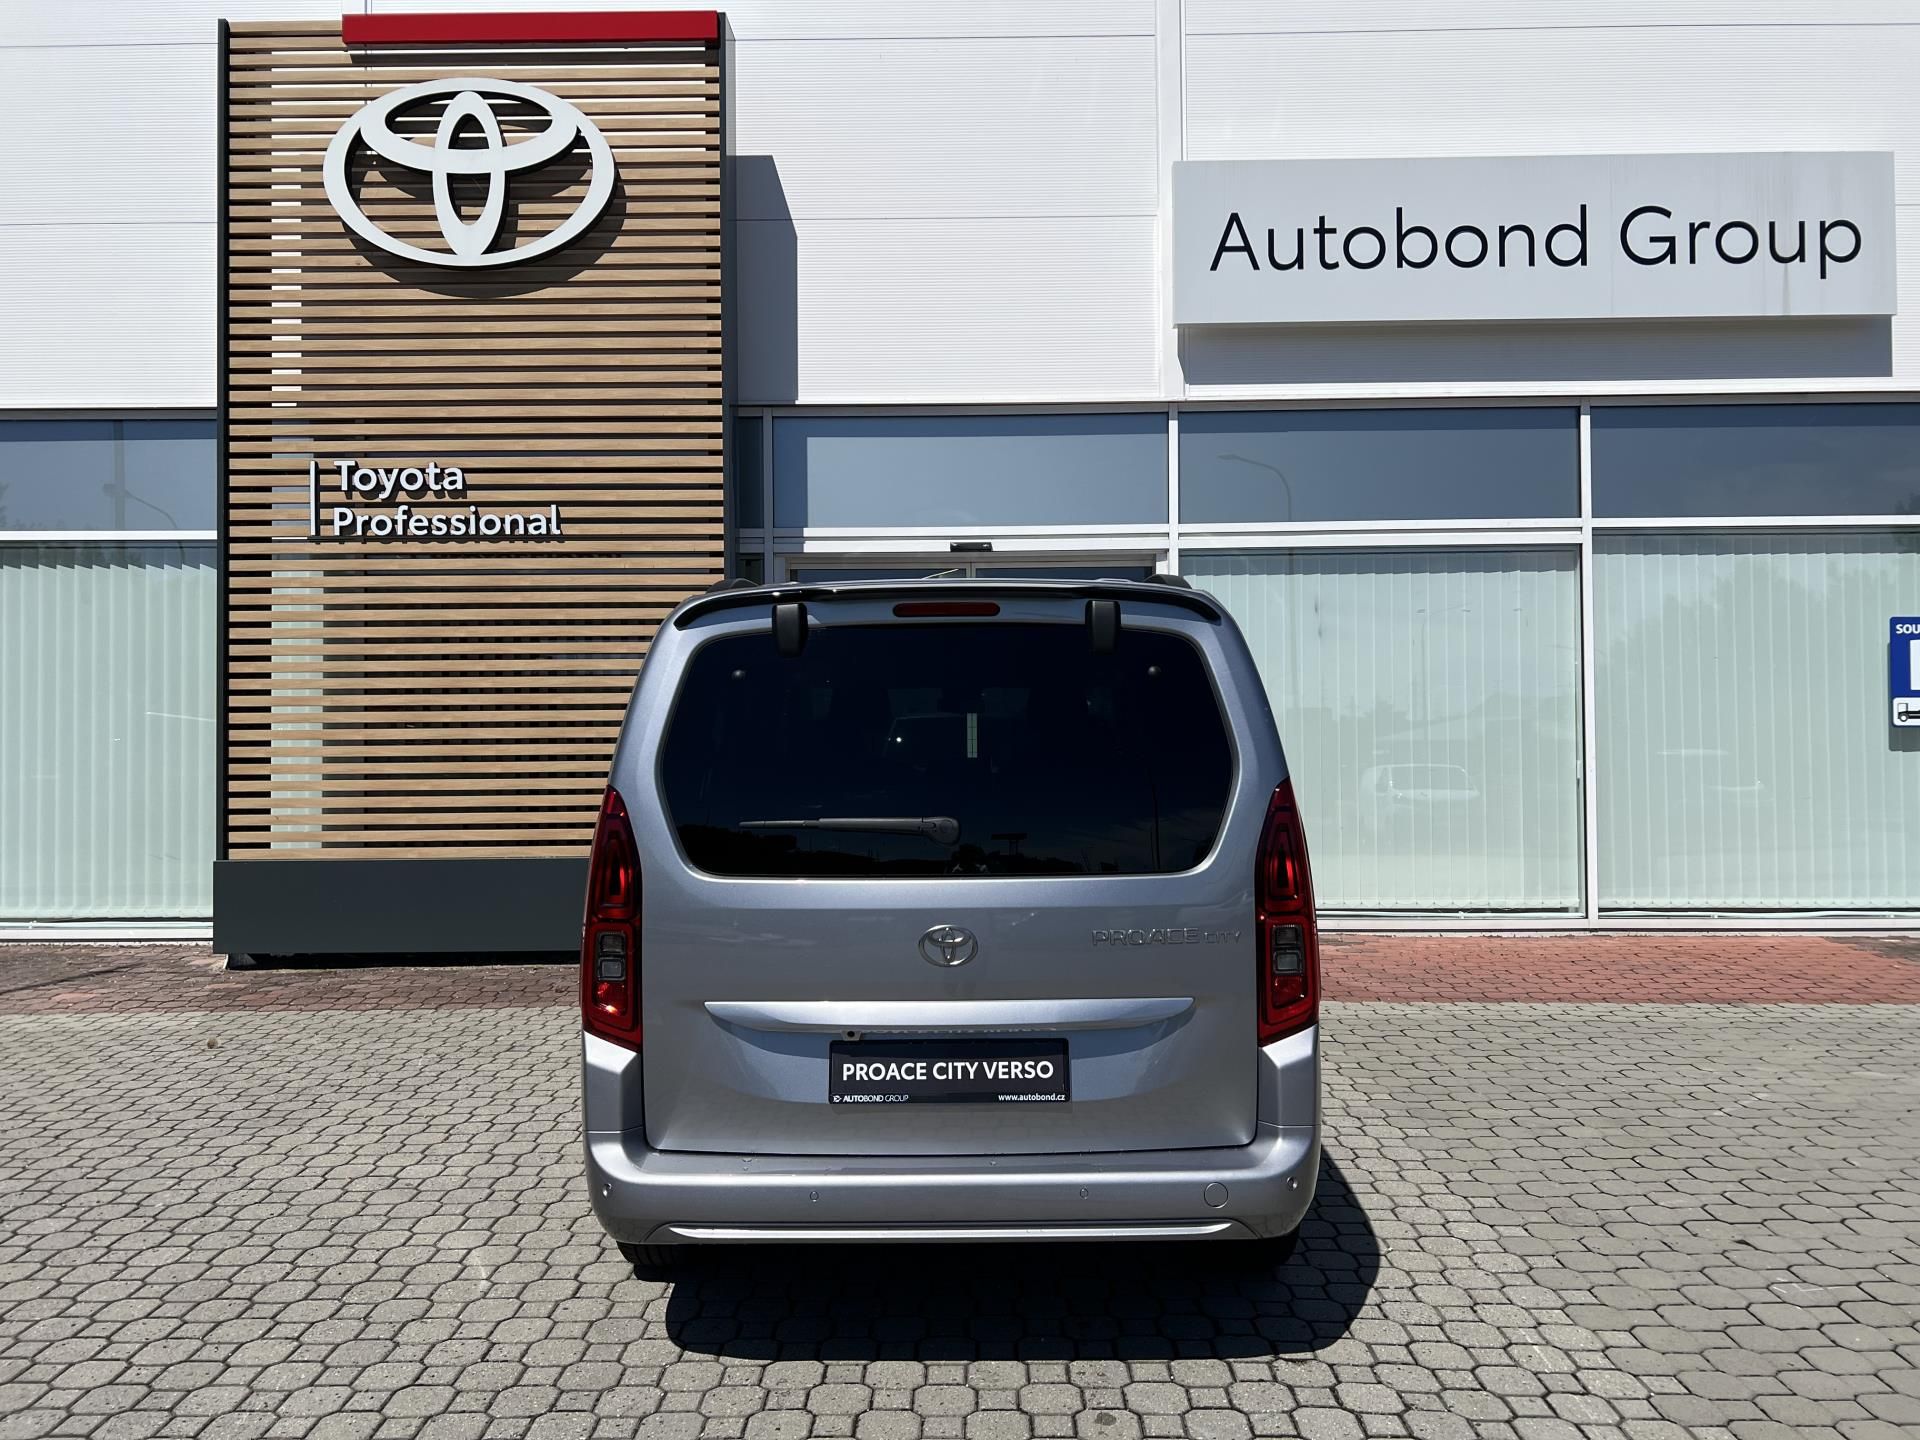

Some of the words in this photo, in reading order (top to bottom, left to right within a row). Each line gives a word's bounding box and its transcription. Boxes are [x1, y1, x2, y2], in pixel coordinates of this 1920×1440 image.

[1209, 203, 1588, 271] Autobond
[1619, 205, 1862, 279] Group
[333, 460, 464, 499] Toyota
[333, 504, 561, 536] Professional
[1092, 928, 1200, 946] PROACE
[1204, 931, 1242, 944] CITY
[842, 1062, 927, 1081] PROACE
[932, 1061, 978, 1080] CITY
[982, 1060, 1054, 1079] VERSO
[842, 1094, 884, 1103] AUTOBOND
[884, 1094, 909, 1102] GROUP
[998, 1092, 1066, 1101] www.autobond.cz
